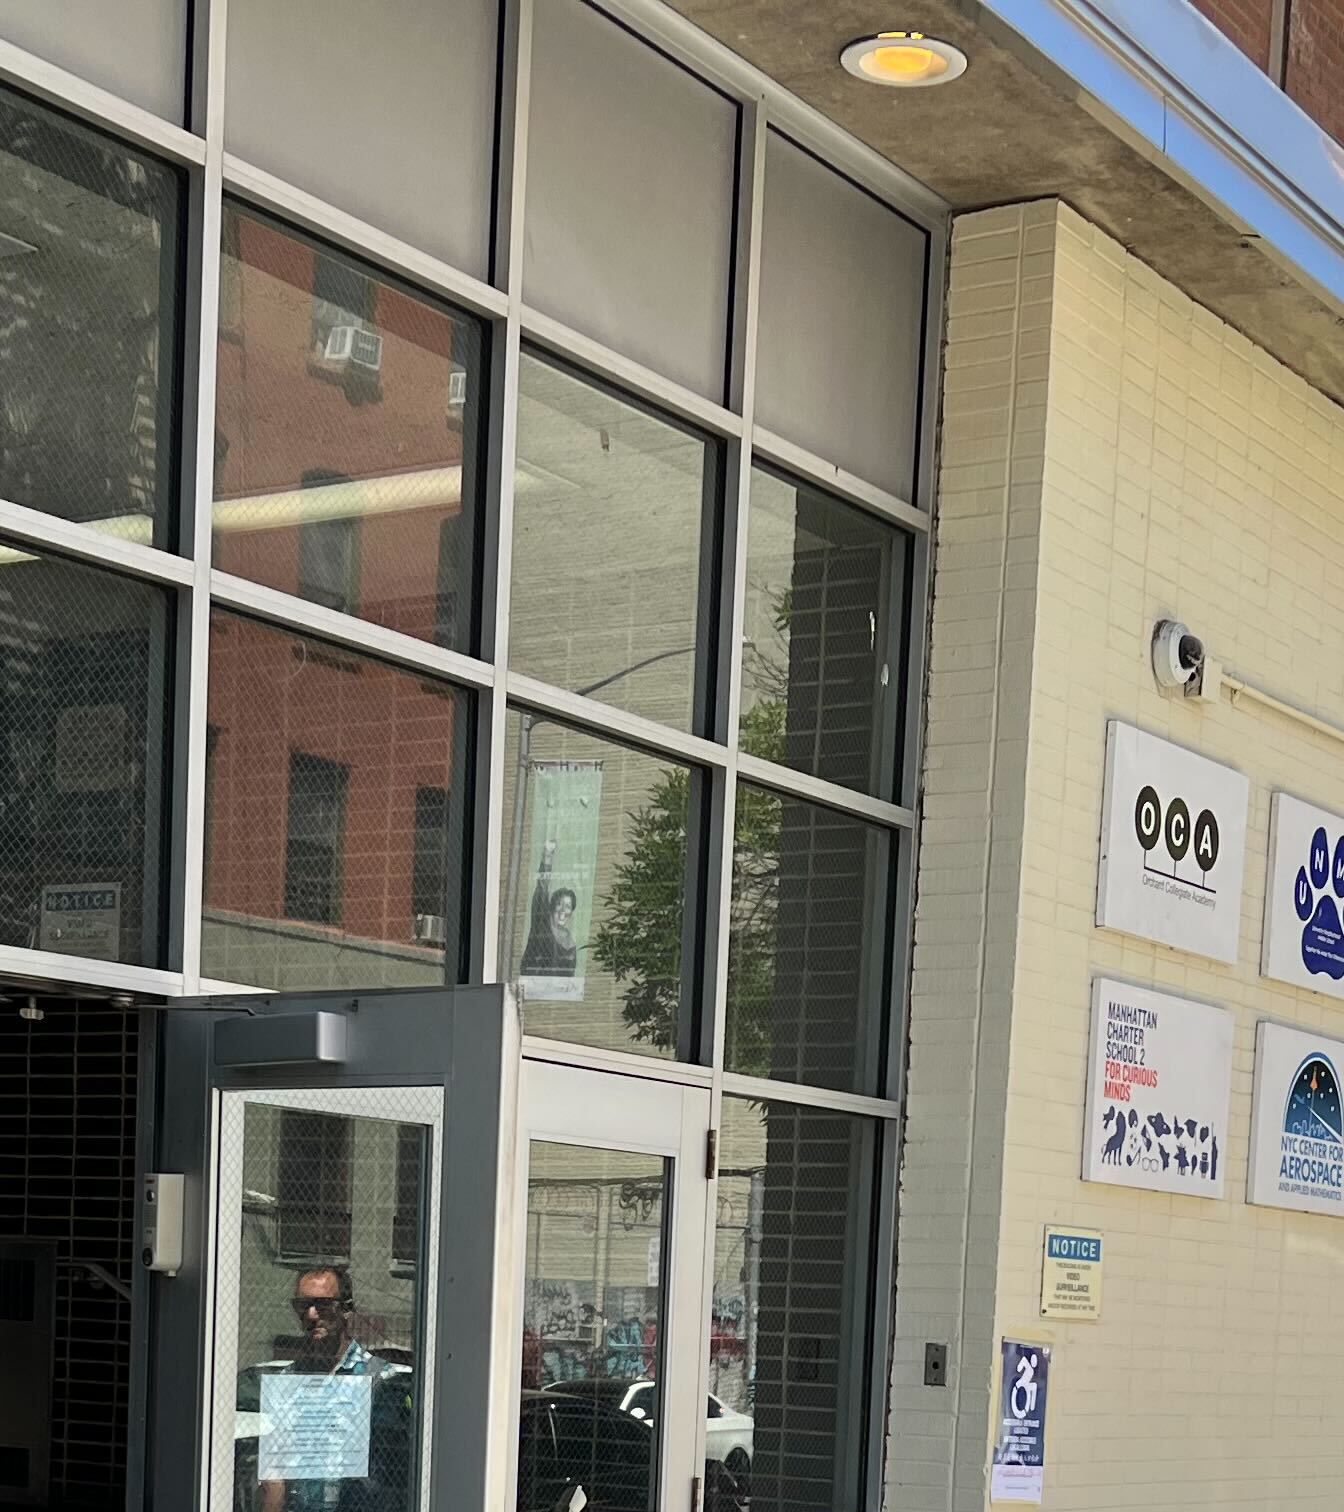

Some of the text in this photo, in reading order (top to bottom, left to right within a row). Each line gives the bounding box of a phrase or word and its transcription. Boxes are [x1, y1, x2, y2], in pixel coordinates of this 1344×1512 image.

[1140, 801, 1213, 859] OCA
[1108, 1001, 1158, 1030] MANHATTAN
[1107, 1021, 1144, 1046] CHARTER
[1105, 1041, 1145, 1066] SCHOOL 2
[1104, 1060, 1158, 1088] FOR CURIOUS
[1103, 1080, 1131, 1102] MINDS
[1280, 1136, 1344, 1162] NYC CENTER FOR
[1279, 1155, 1343, 1188] AEROSPACE
[1052, 1238, 1097, 1258] NOTICE
